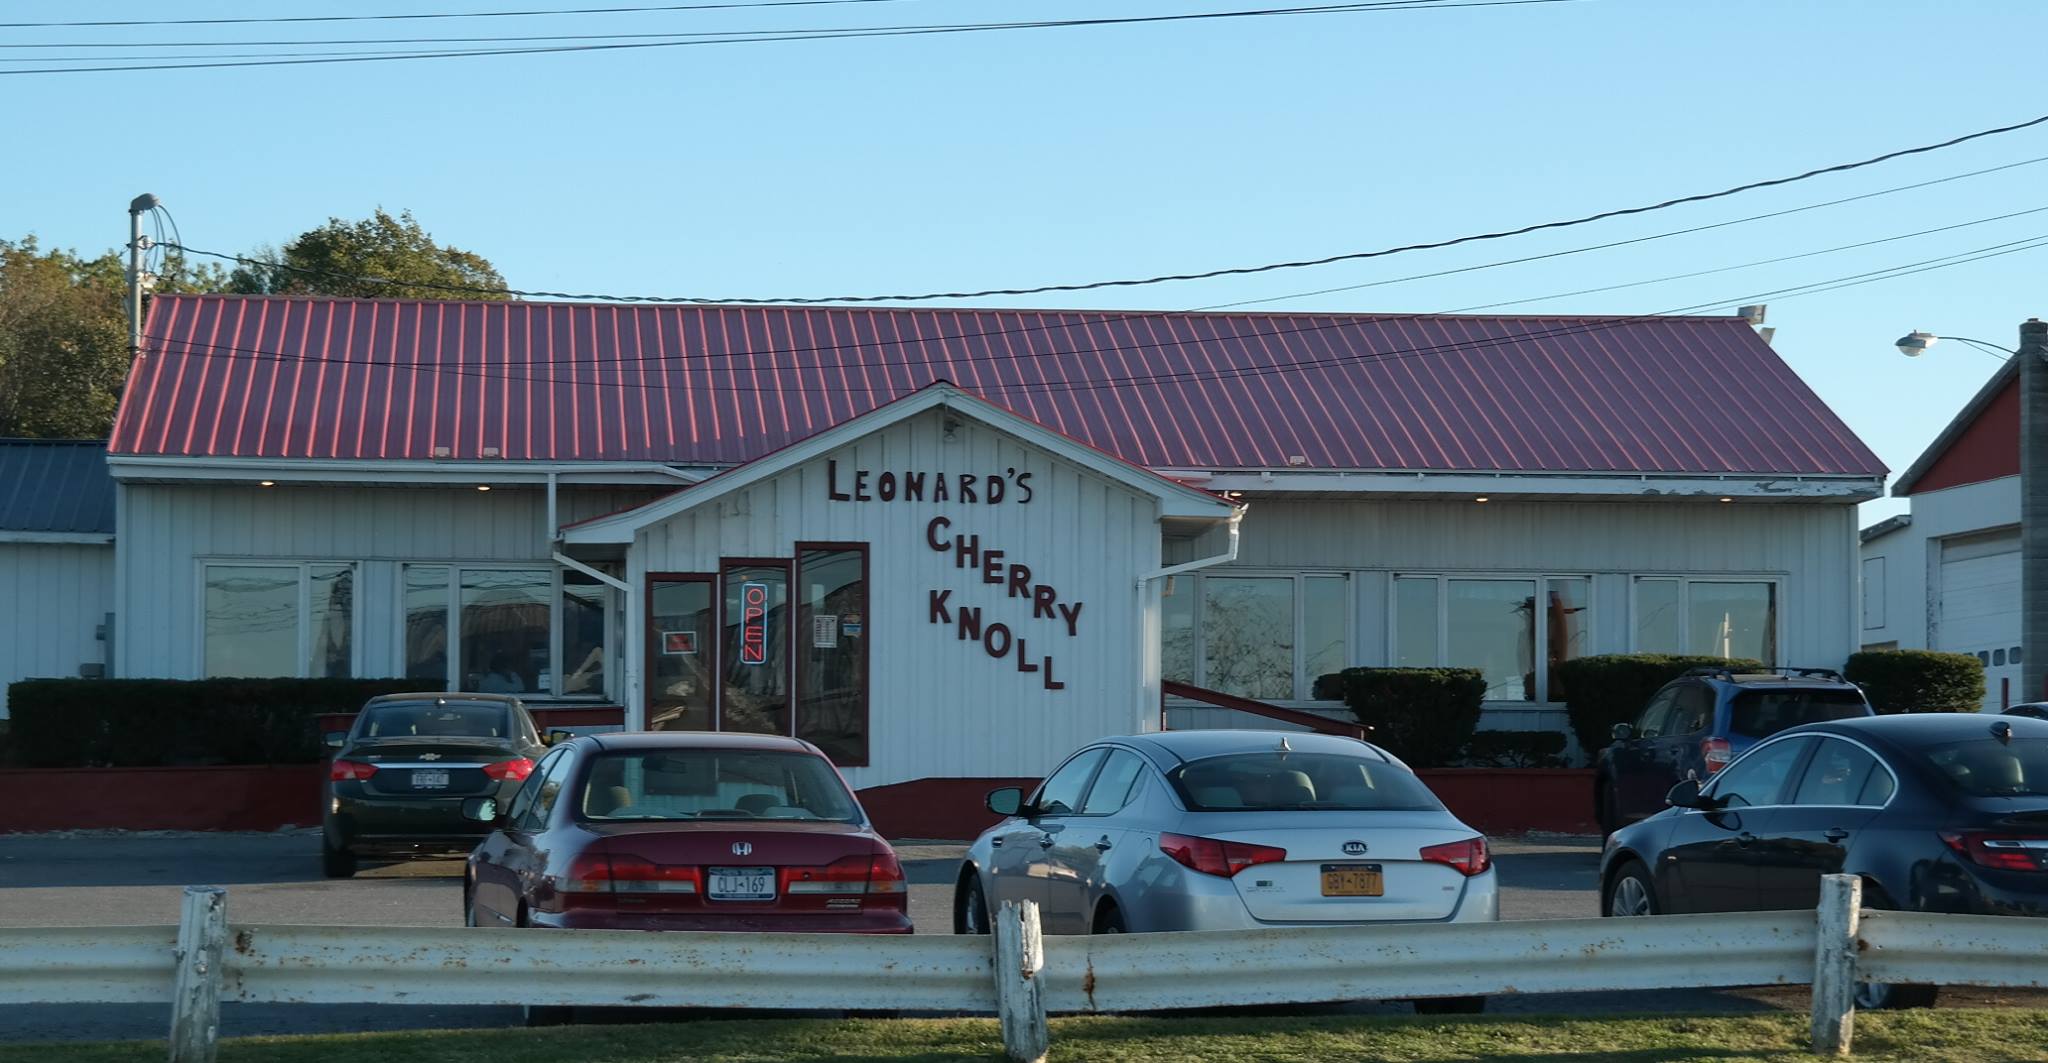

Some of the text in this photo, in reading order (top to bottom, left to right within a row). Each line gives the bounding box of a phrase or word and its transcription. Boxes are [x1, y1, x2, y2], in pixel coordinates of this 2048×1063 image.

[828, 460, 1033, 504] LEONARD'S
[927, 516, 1083, 636] CHERRY
[744, 588, 764, 661] OPEN
[929, 589, 1065, 690] KNOLL
[1346, 844, 1365, 852] KIA
